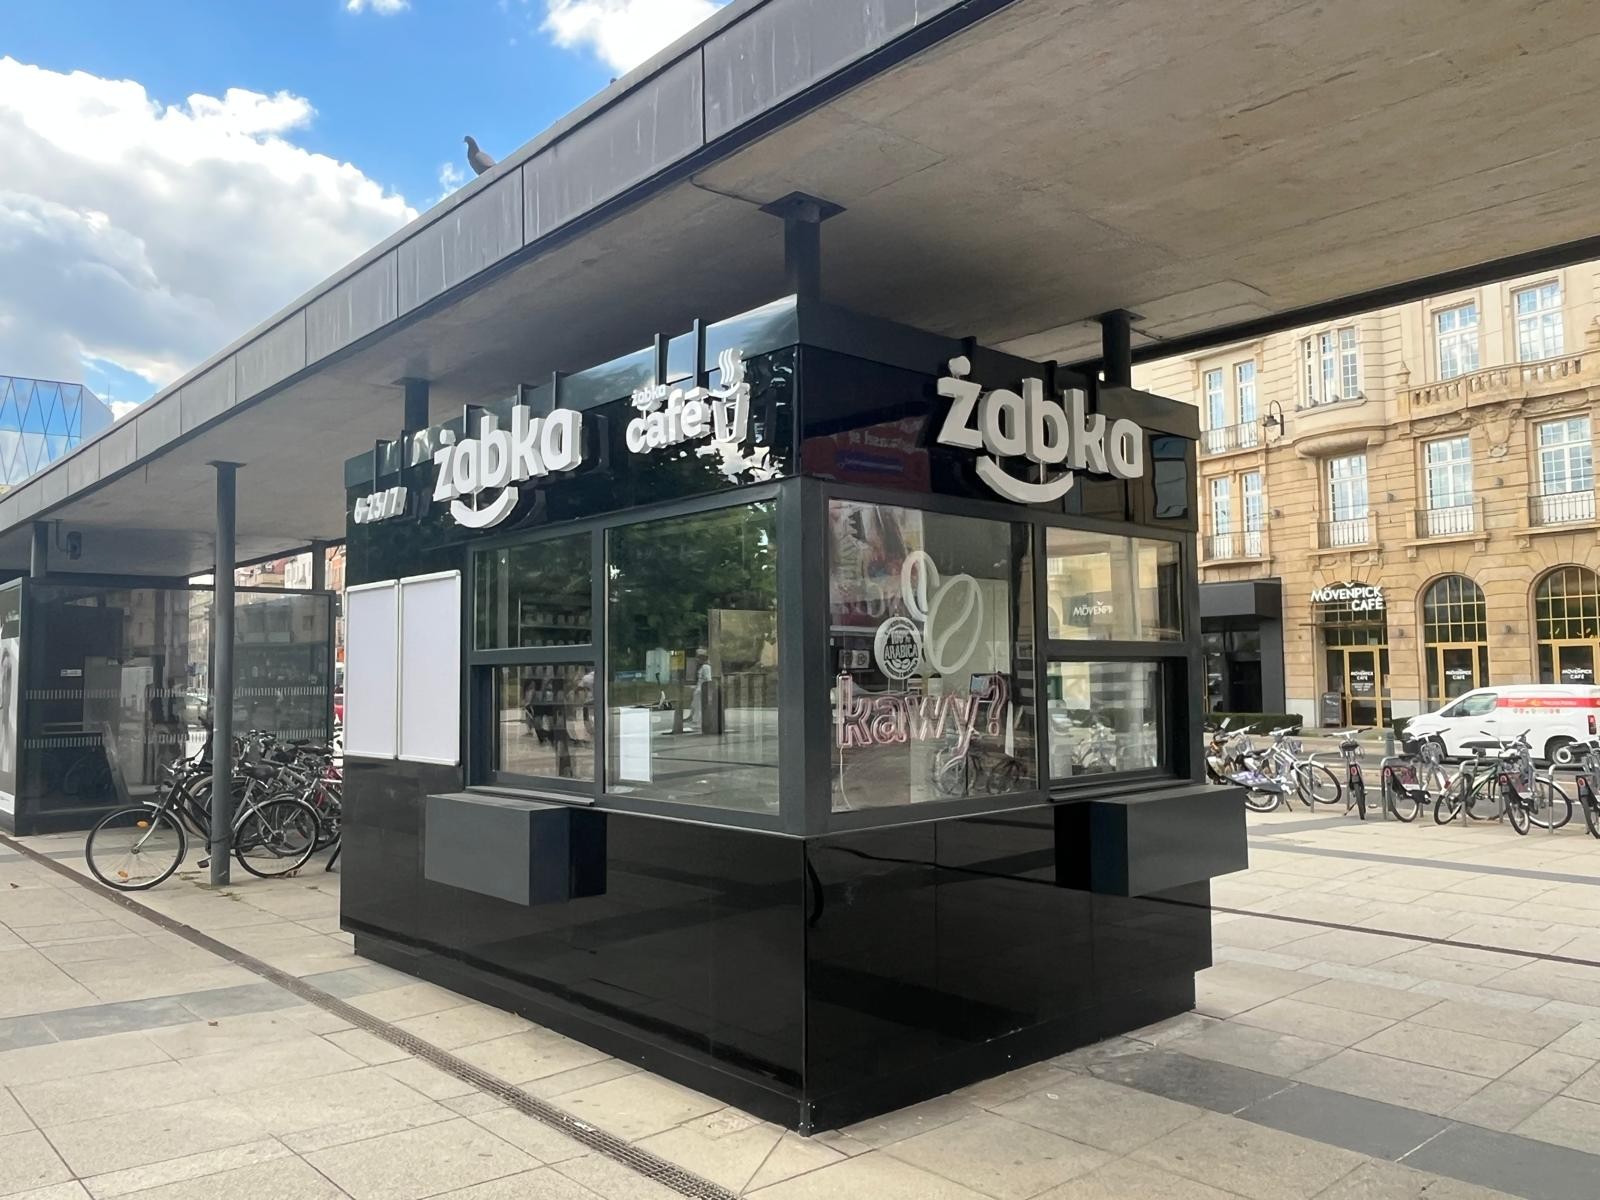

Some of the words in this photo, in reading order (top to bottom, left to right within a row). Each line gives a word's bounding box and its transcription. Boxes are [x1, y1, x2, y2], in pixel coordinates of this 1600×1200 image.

[631, 384, 669, 407] żabka
[937, 356, 1143, 479] żabka
[626, 386, 711, 453] café
[433, 405, 582, 502] żabka
[1310, 586, 1383, 603] MÖVENPICK
[1352, 596, 1384, 611] CAFÉ
[883, 643, 919, 661] ARABICA
[837, 672, 1008, 764] kawy?
